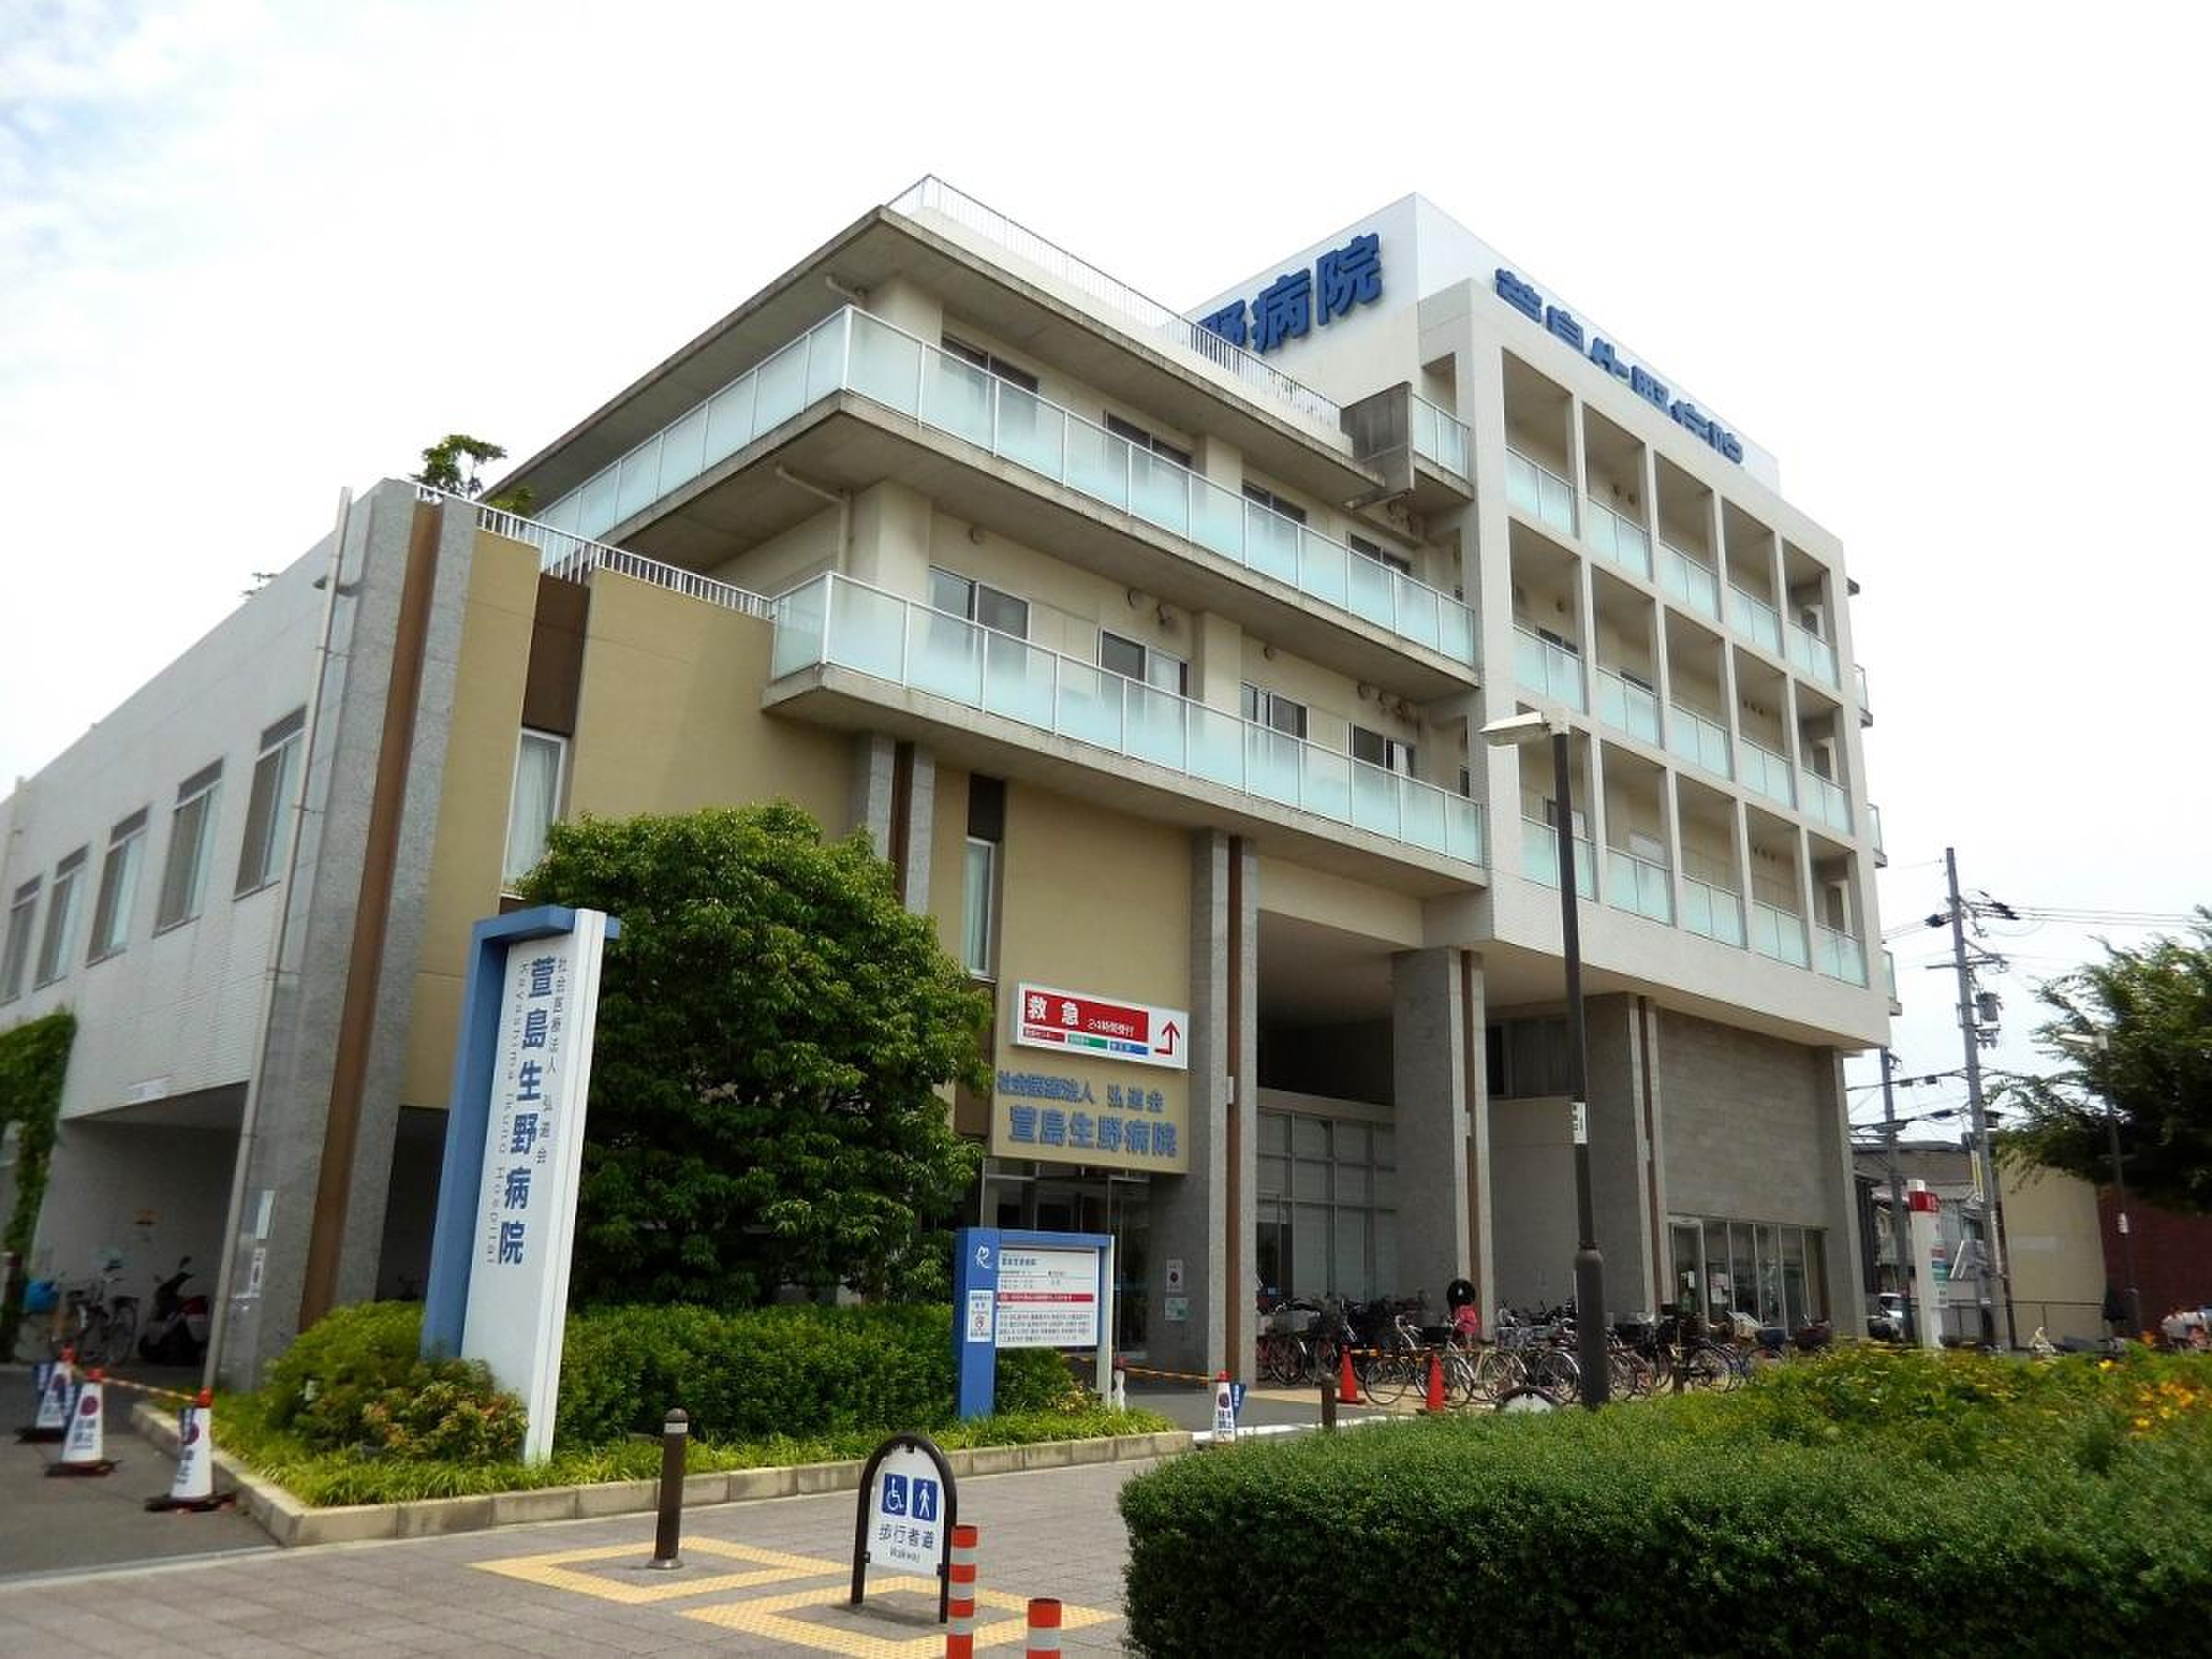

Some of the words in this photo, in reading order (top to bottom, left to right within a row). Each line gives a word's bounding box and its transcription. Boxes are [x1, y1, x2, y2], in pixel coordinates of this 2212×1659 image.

[1027, 995, 1079, 1026] 救急
[499, 956, 556, 1265] 萱島生野病院
[1009, 1105, 1177, 1157] 萱島生野病院
